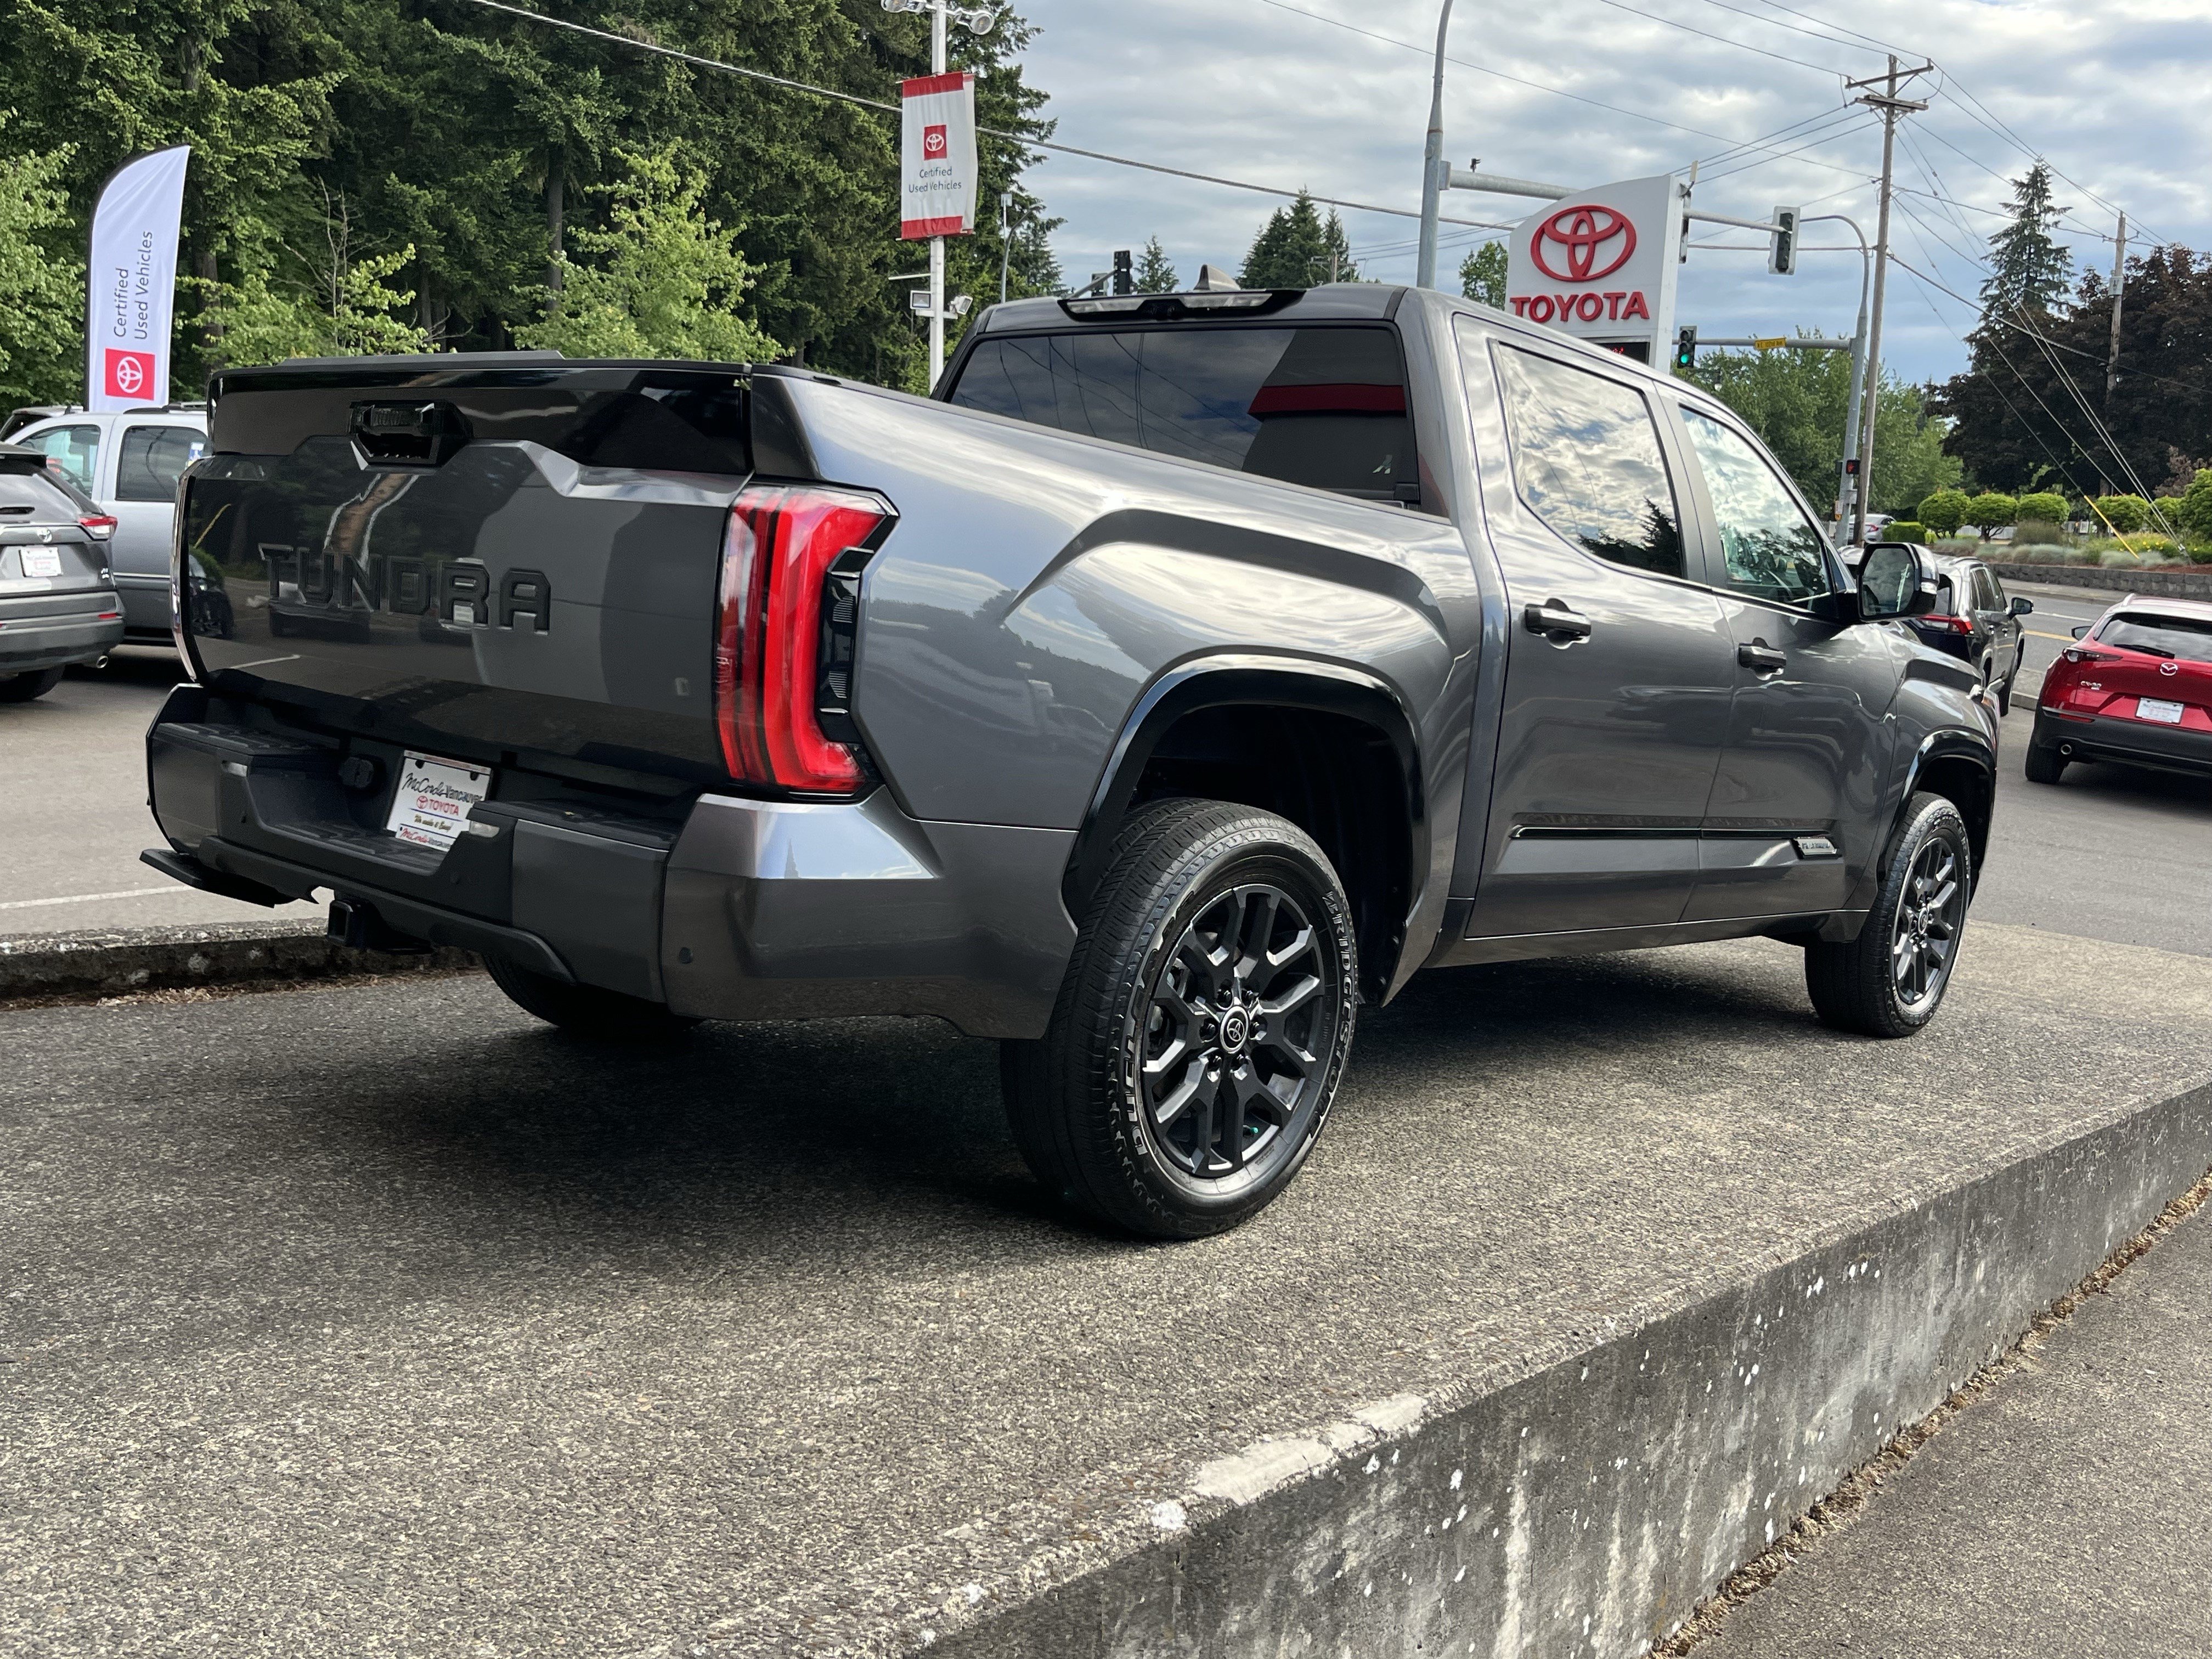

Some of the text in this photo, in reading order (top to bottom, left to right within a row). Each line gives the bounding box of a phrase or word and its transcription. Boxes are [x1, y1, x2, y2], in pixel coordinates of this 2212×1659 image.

[909, 180, 962, 193] Used Vehicles
[919, 166, 952, 178] Certified
[134, 231, 153, 340] Used Vehicles
[114, 268, 129, 337] Certified
[1510, 291, 1650, 323] TOYOTA
[258, 543, 551, 635] TUNDRA
[429, 799, 459, 816] TOYOTA
